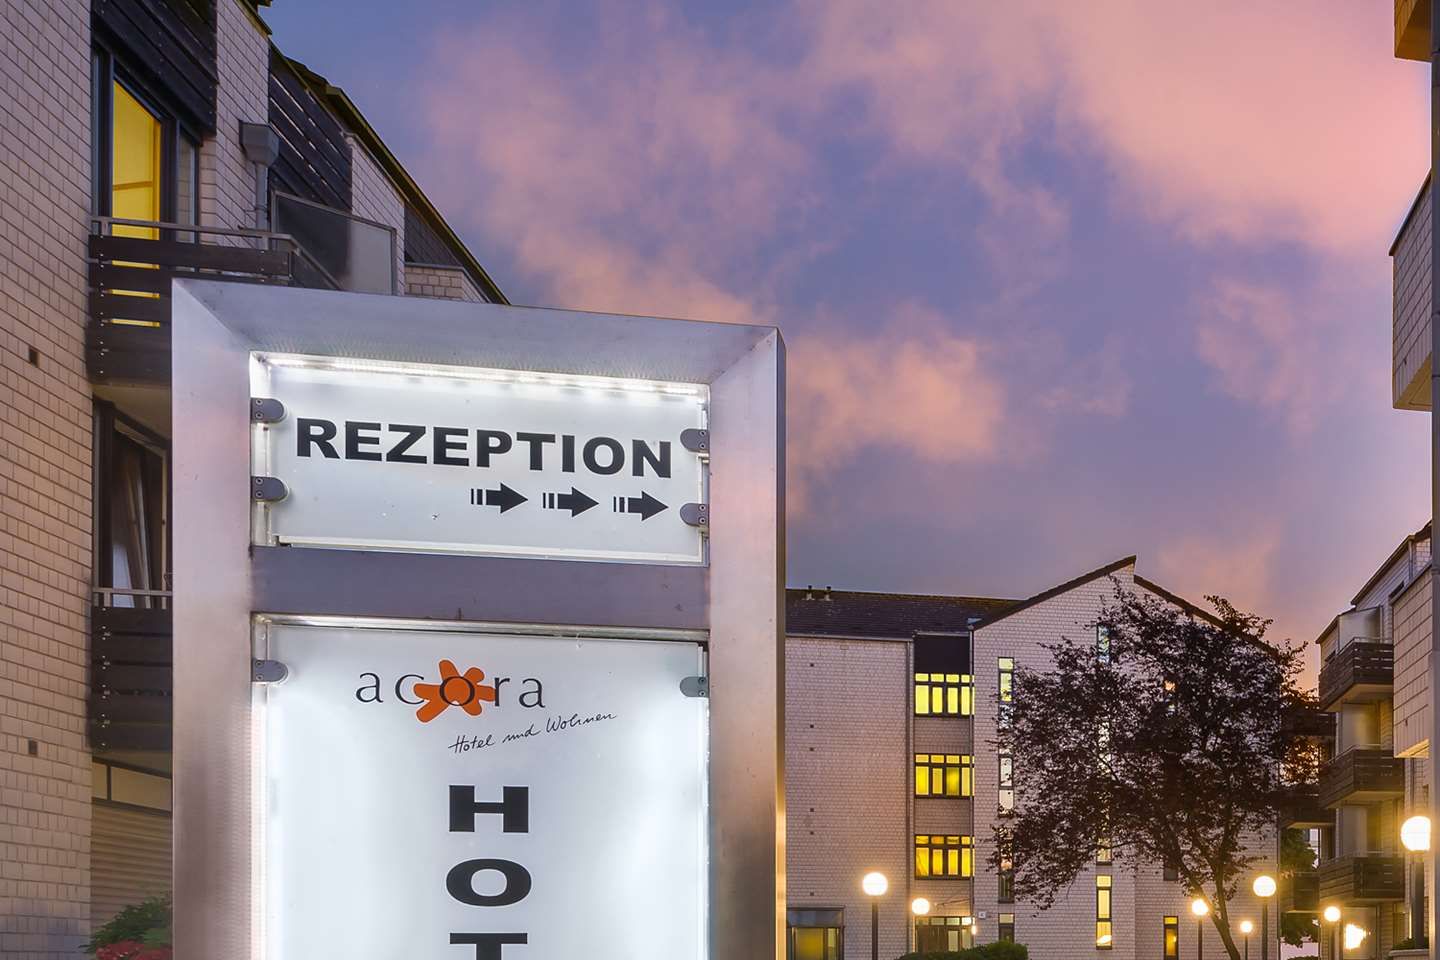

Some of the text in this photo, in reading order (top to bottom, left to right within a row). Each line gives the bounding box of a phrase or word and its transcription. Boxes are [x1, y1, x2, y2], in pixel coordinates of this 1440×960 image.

[296, 418, 672, 479] REZEPTION
[355, 672, 546, 708] acora
[448, 711, 618, 753] Hotel und Wohnen
